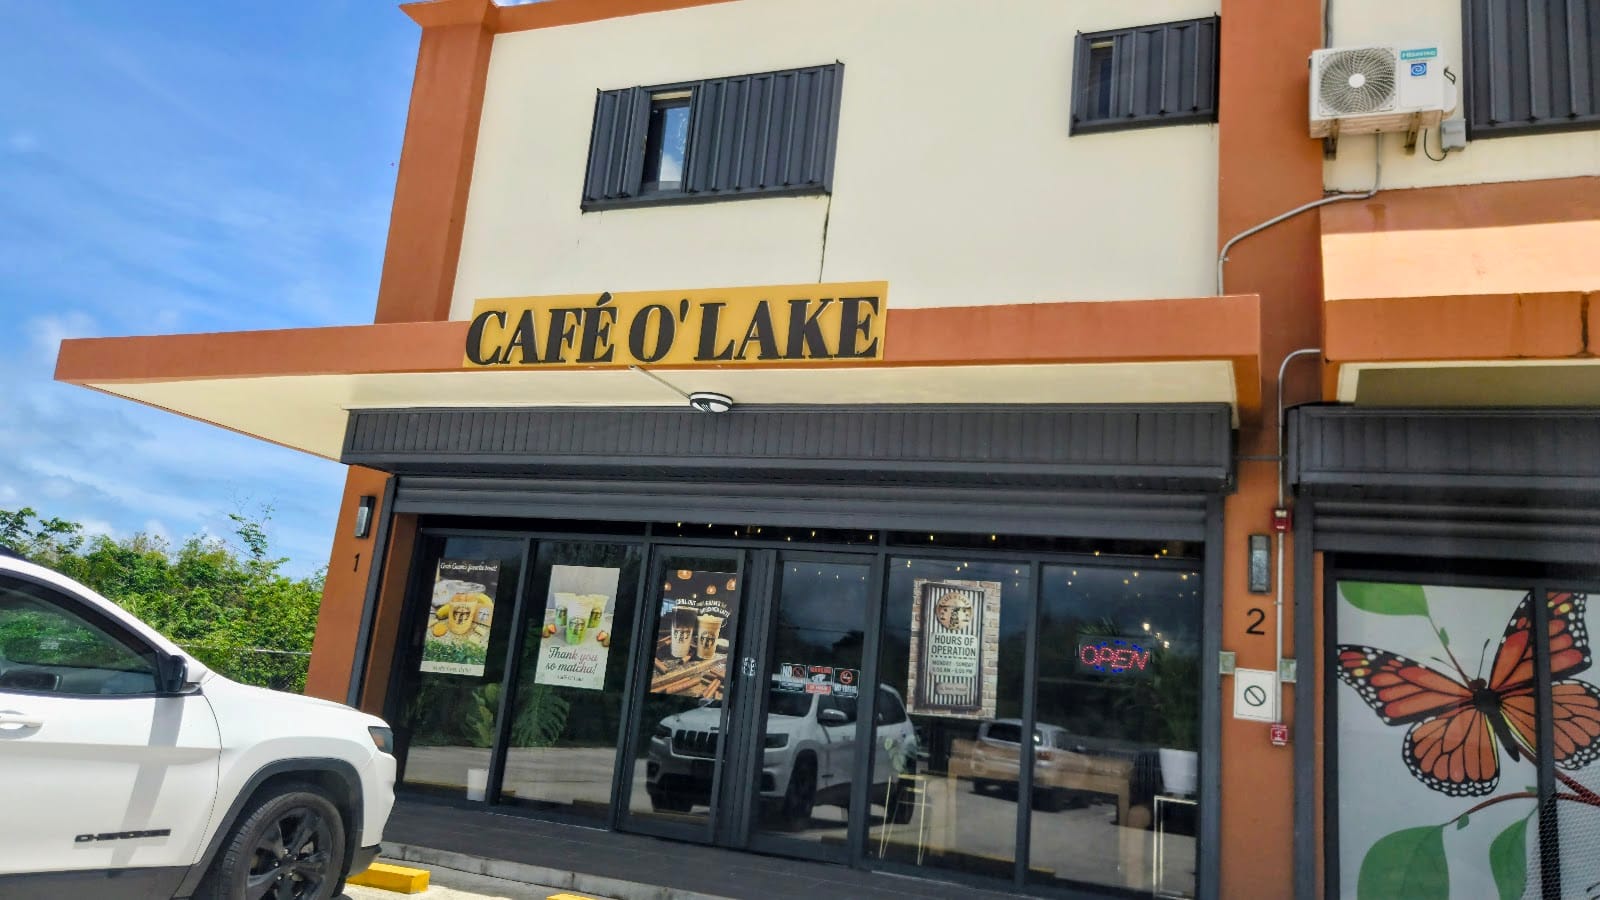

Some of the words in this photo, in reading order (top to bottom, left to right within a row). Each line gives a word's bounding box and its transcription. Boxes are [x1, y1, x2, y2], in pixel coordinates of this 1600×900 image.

[465, 292, 617, 366] CAFÉ
[353, 553, 360, 573] 1
[1246, 608, 1266, 635] 2
[934, 634, 962, 646] HOURS
[964, 637, 974, 647] OF
[548, 646, 578, 660] Thank
[579, 653, 598, 665] you
[931, 644, 976, 657] OPERATION
[1081, 645, 1150, 671] OPEN
[546, 662, 557, 671] so
[557, 661, 598, 675] matcha!
